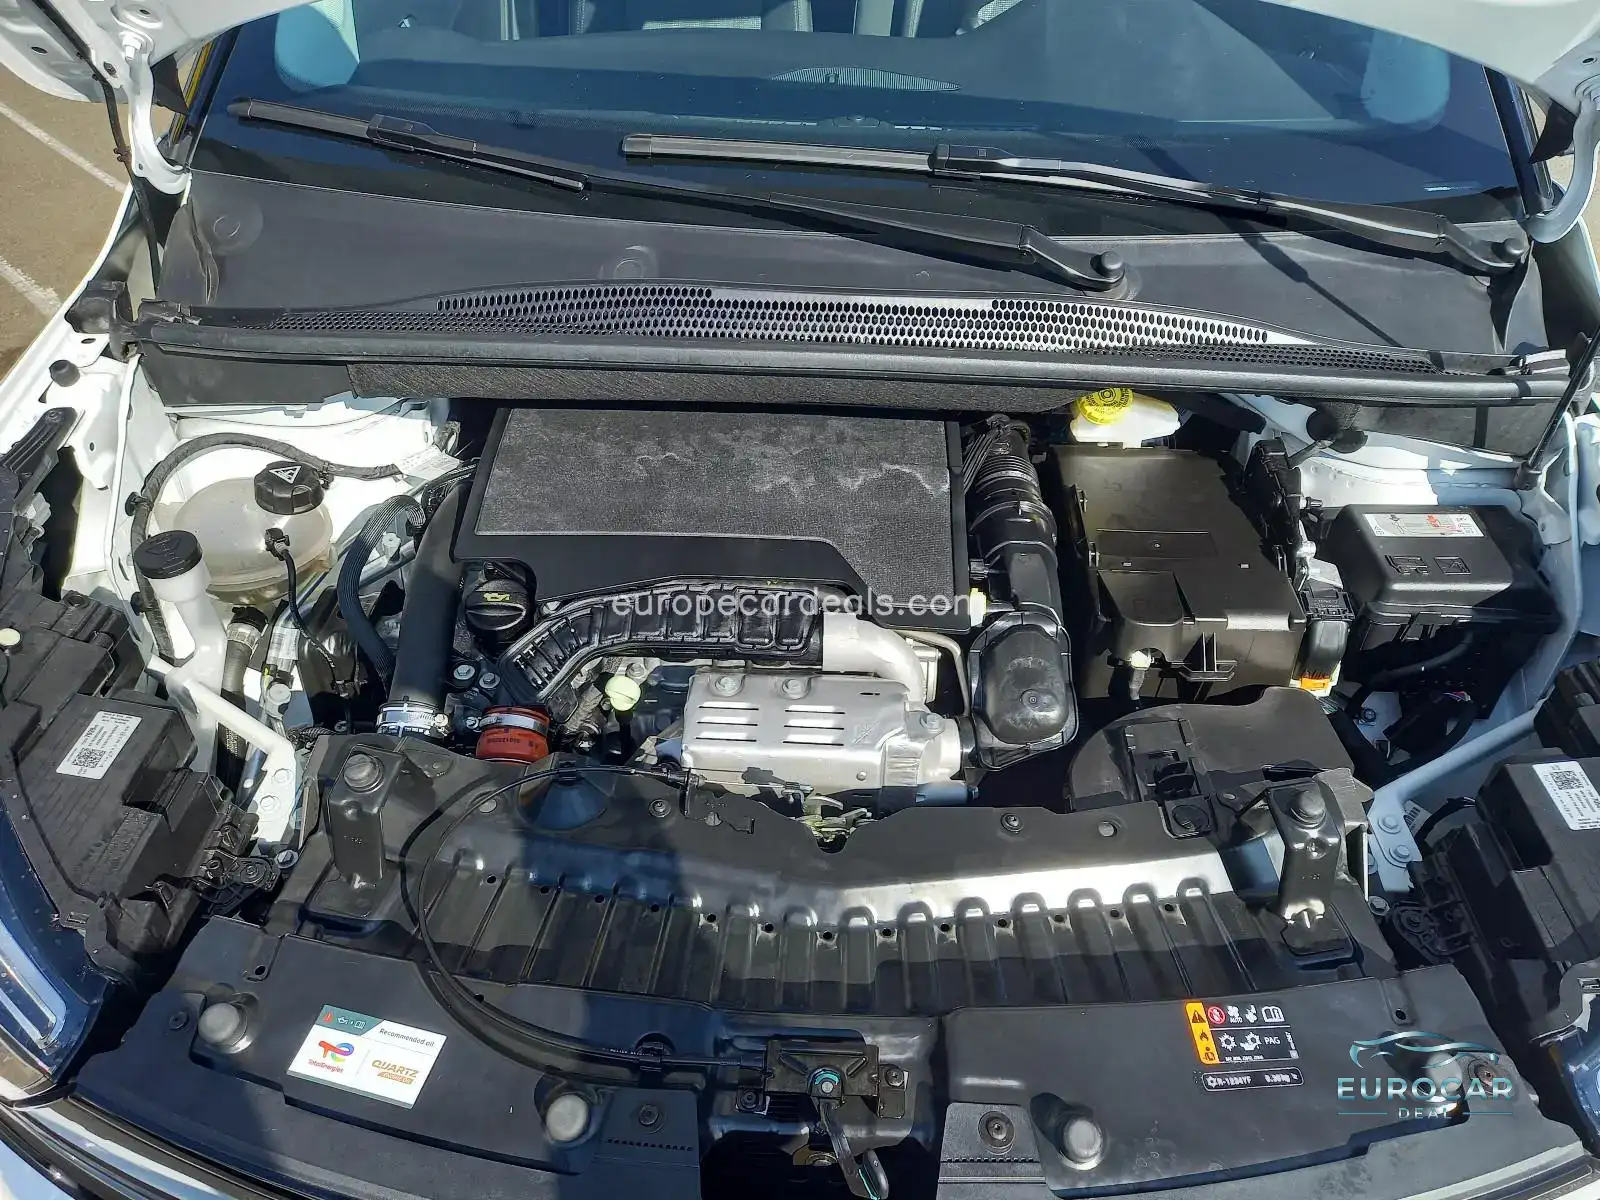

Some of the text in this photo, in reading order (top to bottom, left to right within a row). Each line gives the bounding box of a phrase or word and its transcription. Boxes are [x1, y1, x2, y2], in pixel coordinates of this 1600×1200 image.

[379, 1028, 425, 1046] Recommended
[1264, 1036, 1280, 1045] PAG
[308, 1058, 344, 1073] TotalEnergies
[371, 1060, 420, 1077] QUARTZ
